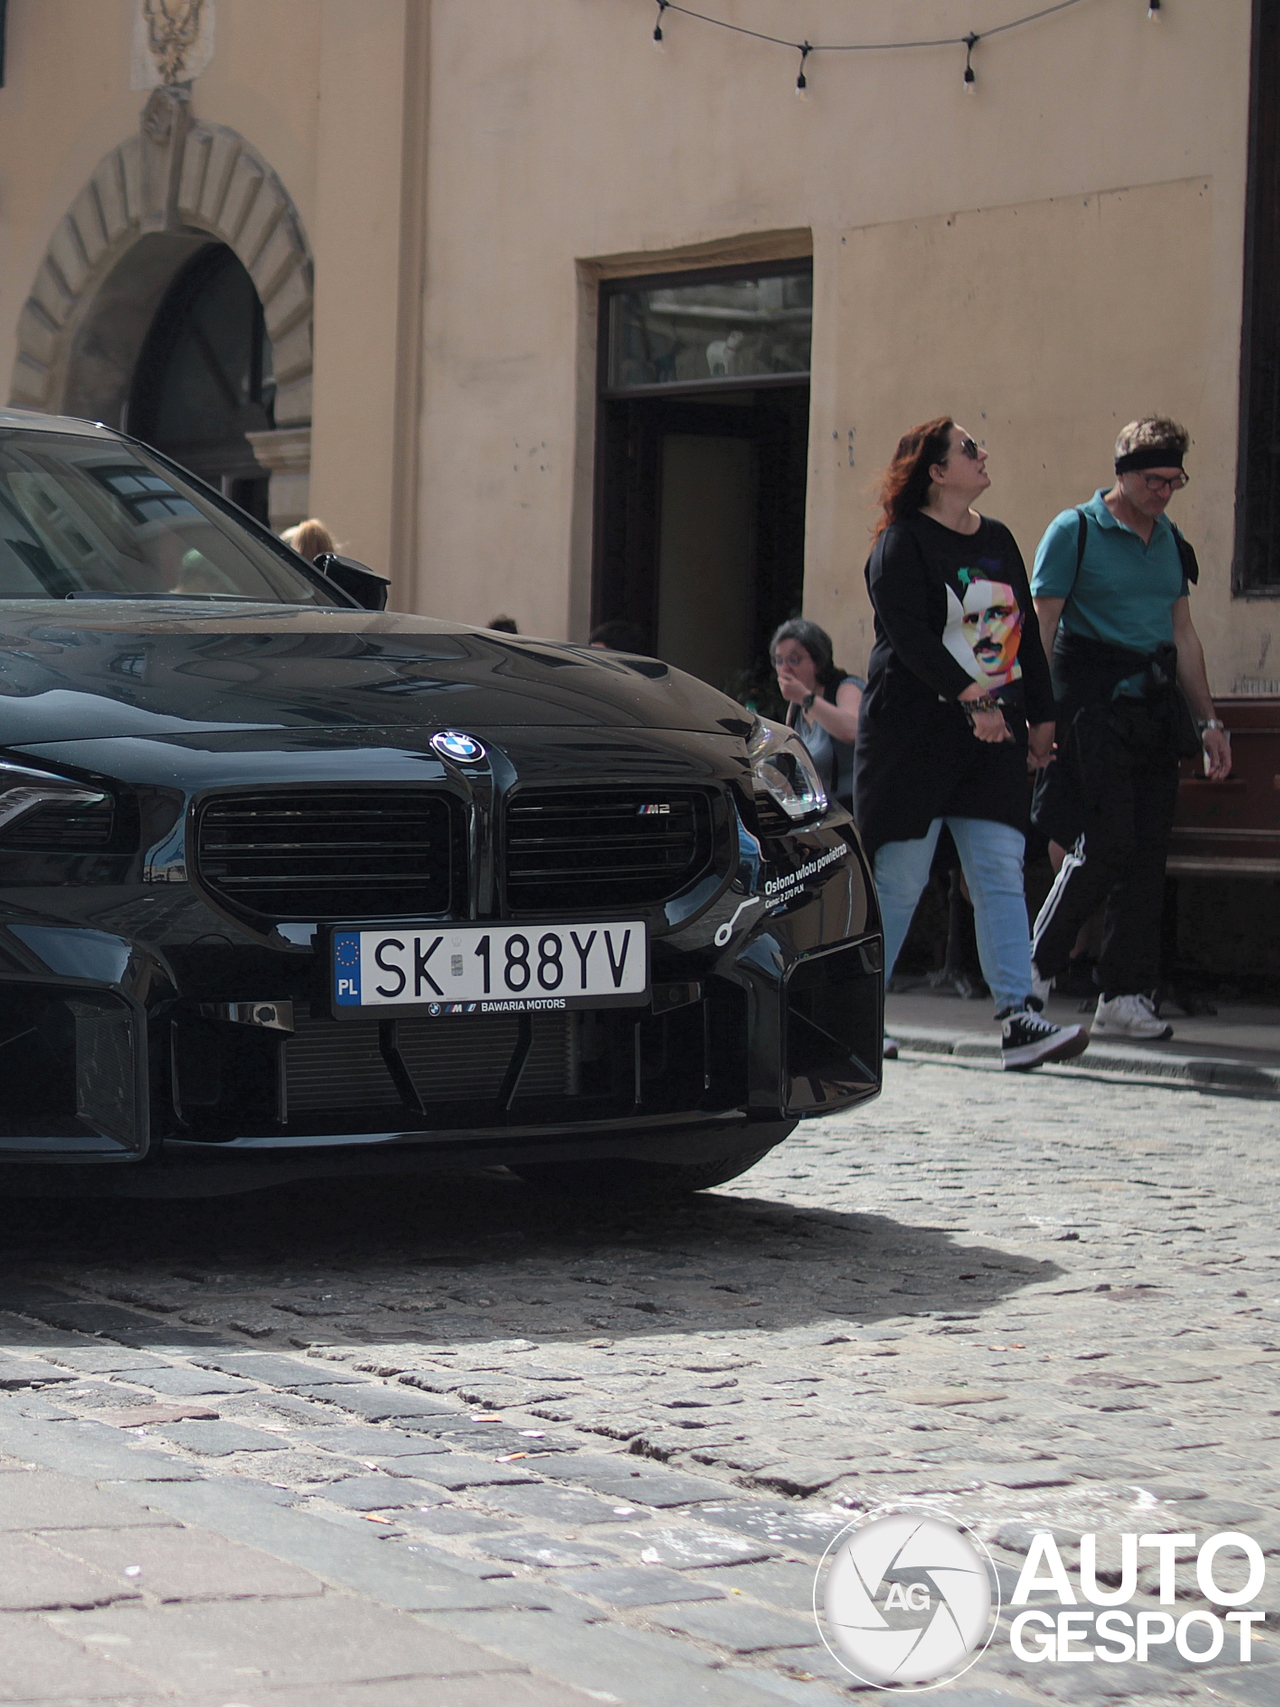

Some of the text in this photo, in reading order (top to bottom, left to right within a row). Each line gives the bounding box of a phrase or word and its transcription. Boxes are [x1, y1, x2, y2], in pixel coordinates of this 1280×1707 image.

[794, 884, 804, 895] PLN
[375, 929, 631, 998] SK 188YV
[338, 979, 358, 996] PL
[481, 1000, 525, 1012] BAWARIA
[526, 998, 566, 1010] MOTORS
